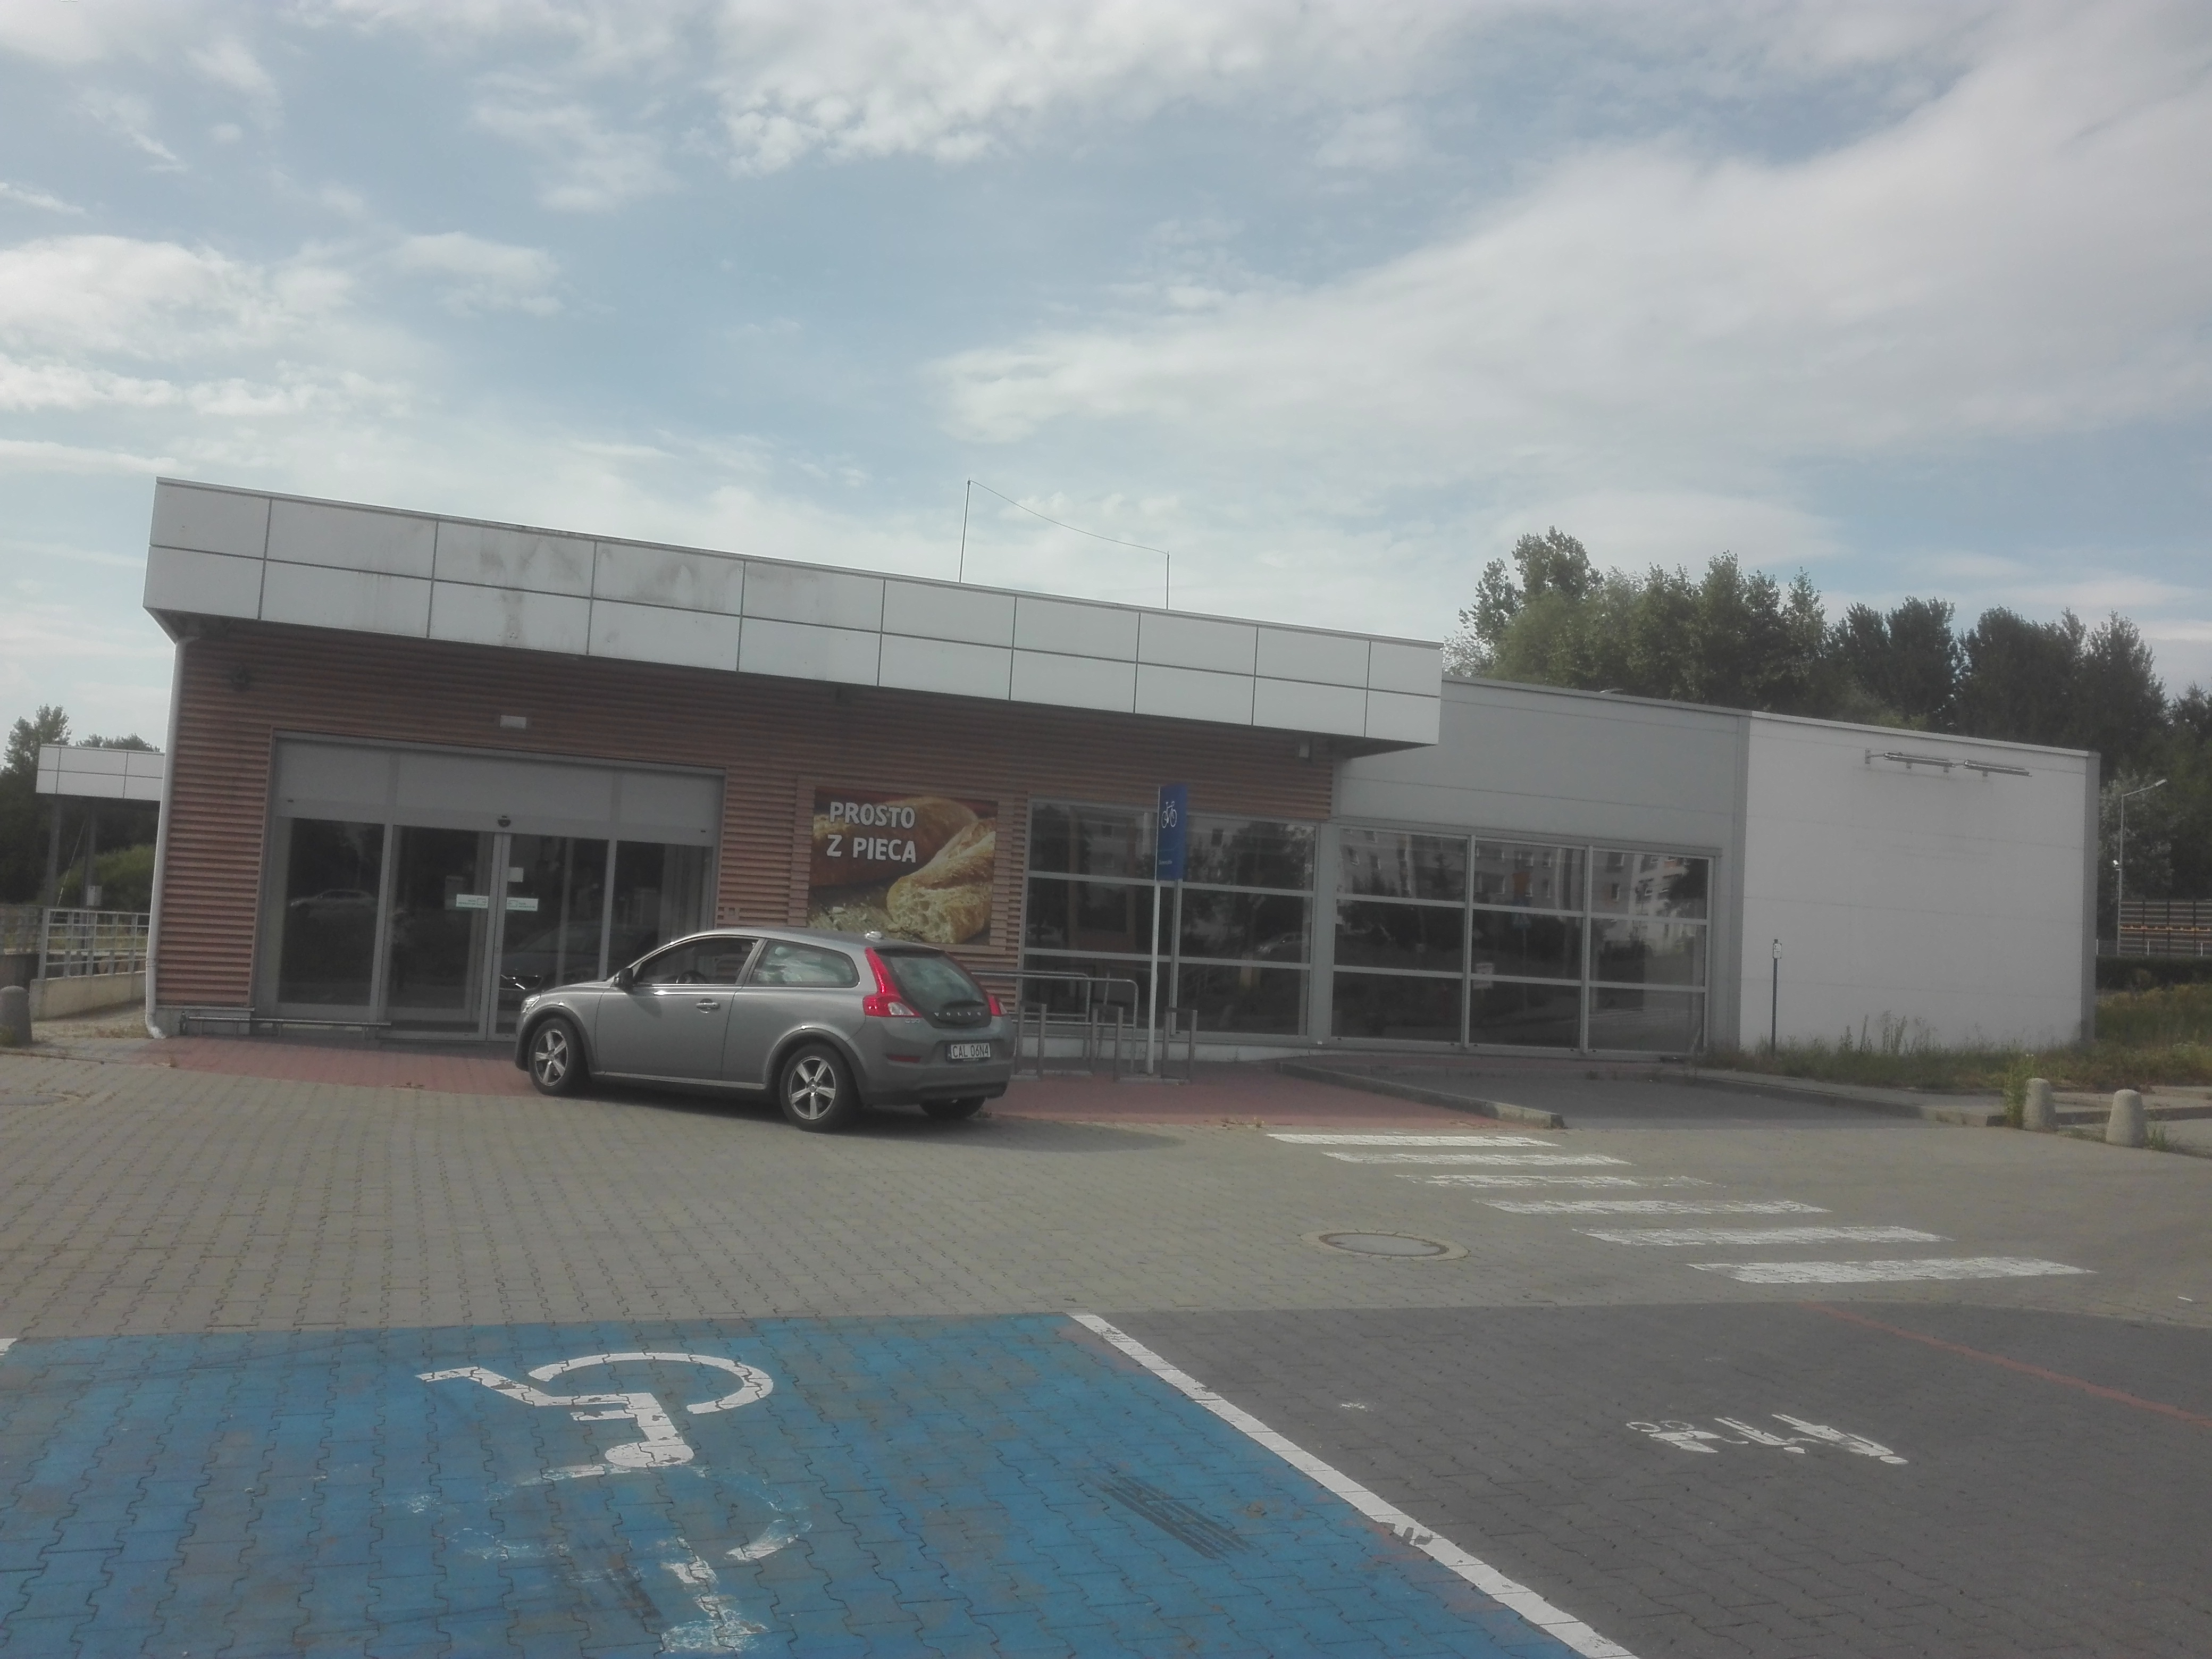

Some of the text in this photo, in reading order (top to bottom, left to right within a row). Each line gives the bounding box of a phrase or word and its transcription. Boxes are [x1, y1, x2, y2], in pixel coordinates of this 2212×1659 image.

[830, 801, 916, 829] PROSTO
[826, 834, 916, 863] Z PIECA
[953, 1045, 989, 1058] CAL 06N4
